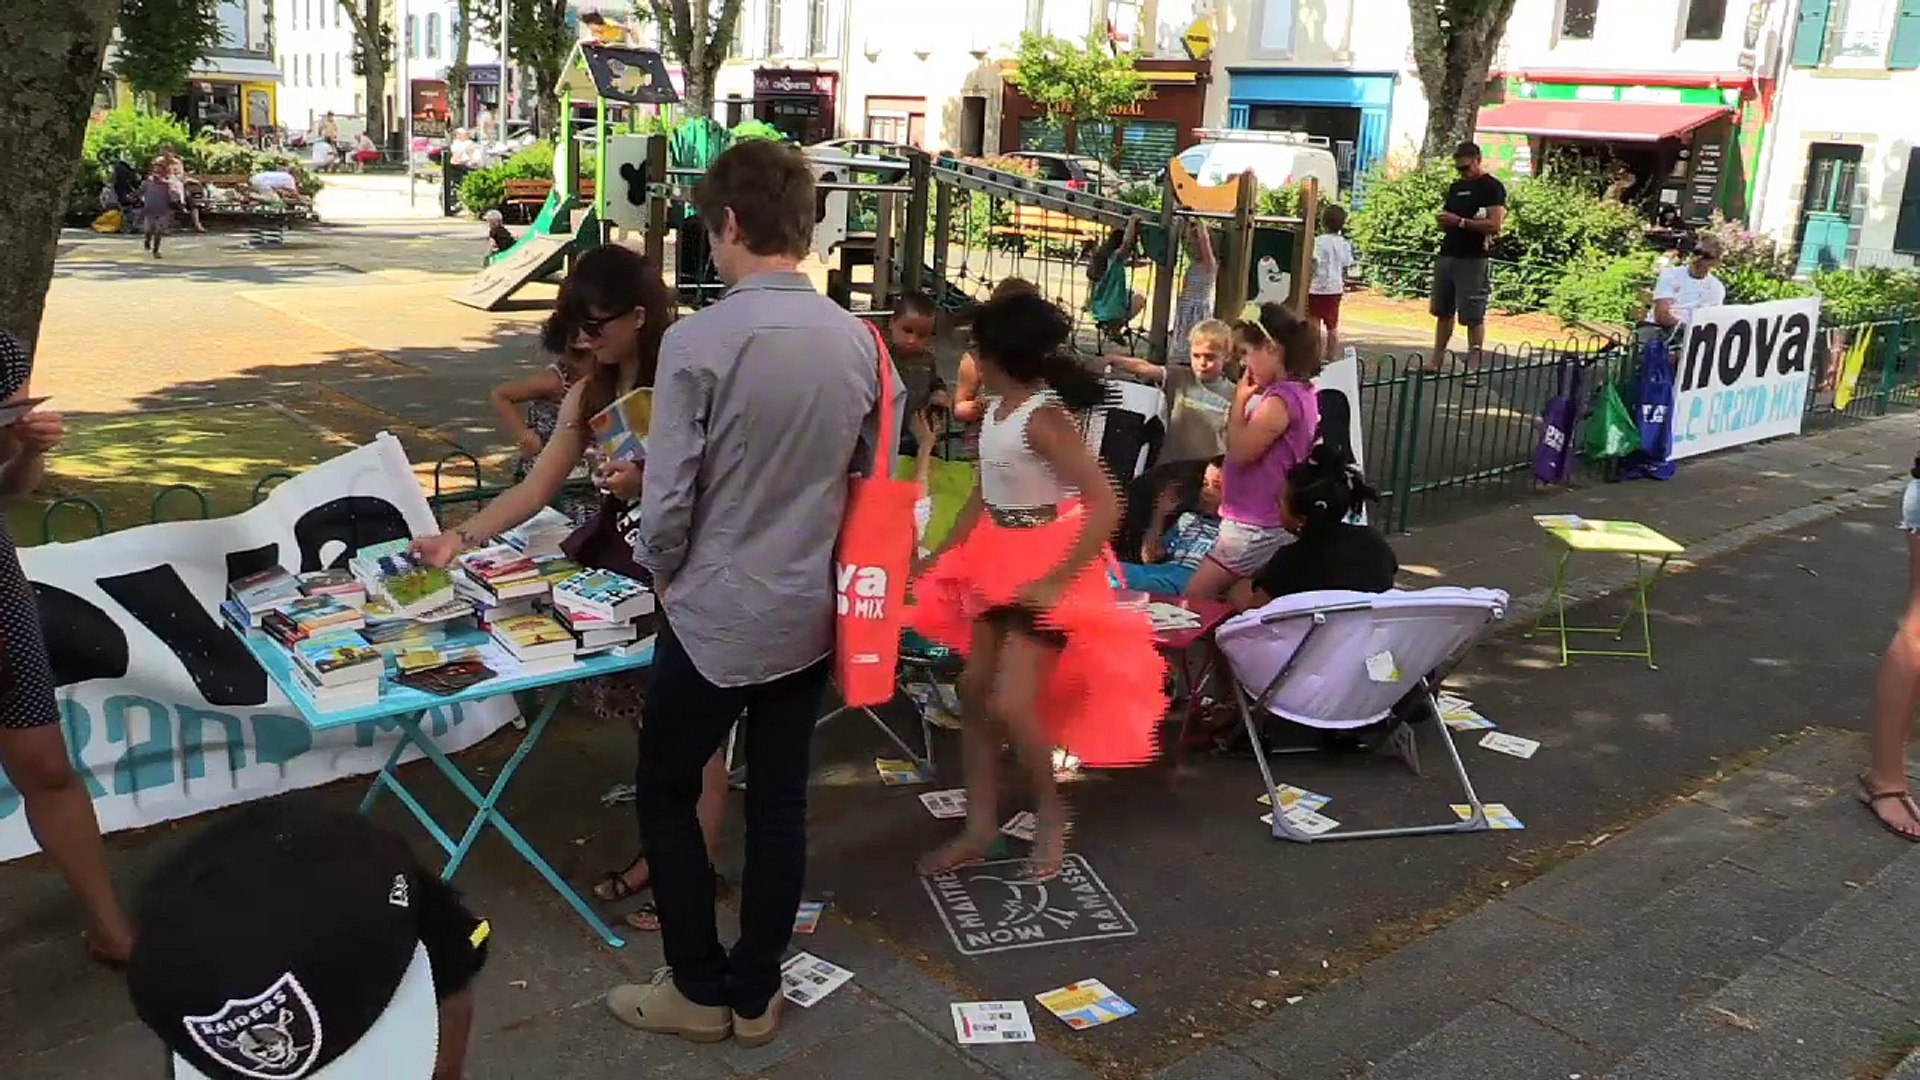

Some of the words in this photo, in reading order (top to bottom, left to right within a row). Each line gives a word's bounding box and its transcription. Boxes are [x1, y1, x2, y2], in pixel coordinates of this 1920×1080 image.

[1681, 312, 1810, 392] nova
[1768, 382, 1802, 421] MIX
[854, 598, 885, 619] MIX
[966, 924, 1046, 948] MON
[200, 990, 288, 1035] RAIDERS
